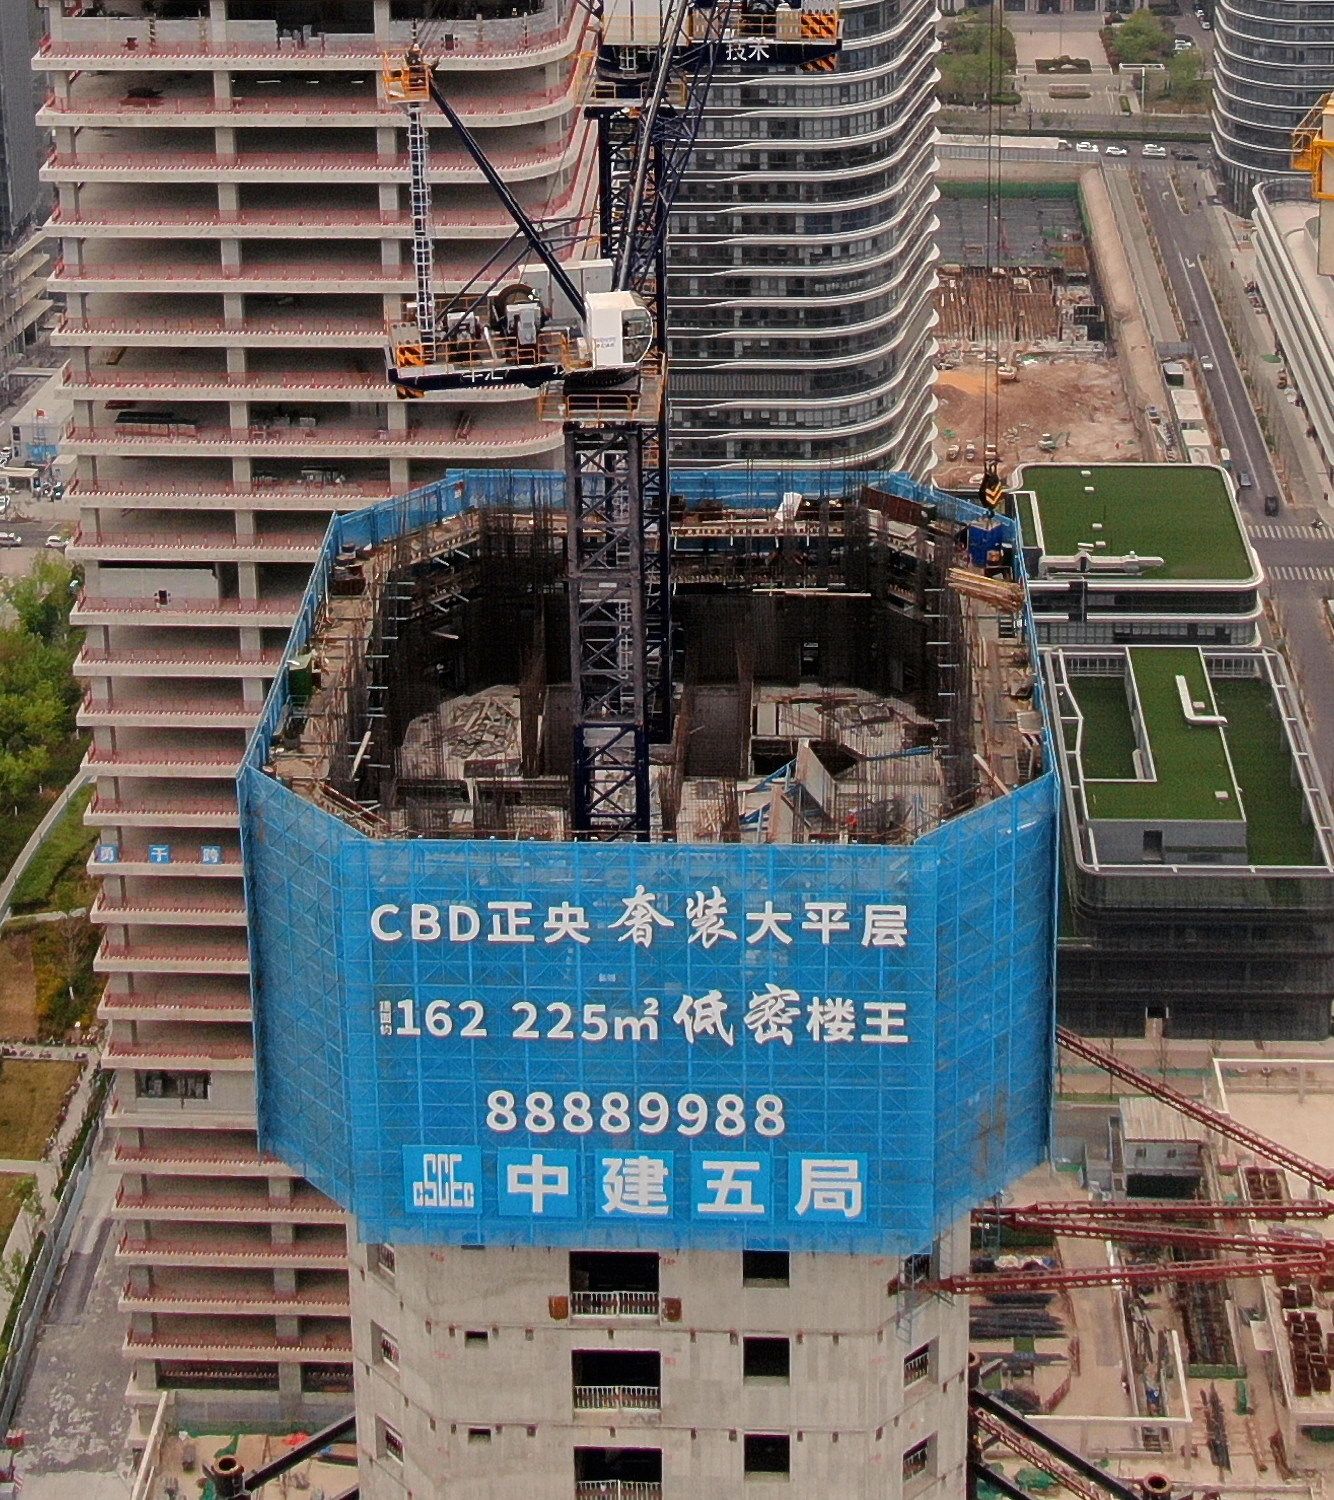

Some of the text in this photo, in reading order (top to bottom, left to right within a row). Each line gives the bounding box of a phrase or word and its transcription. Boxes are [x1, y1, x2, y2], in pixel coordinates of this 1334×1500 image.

[486, 1089, 786, 1138] 88889988
[506, 1154, 865, 1218] 中建五局
